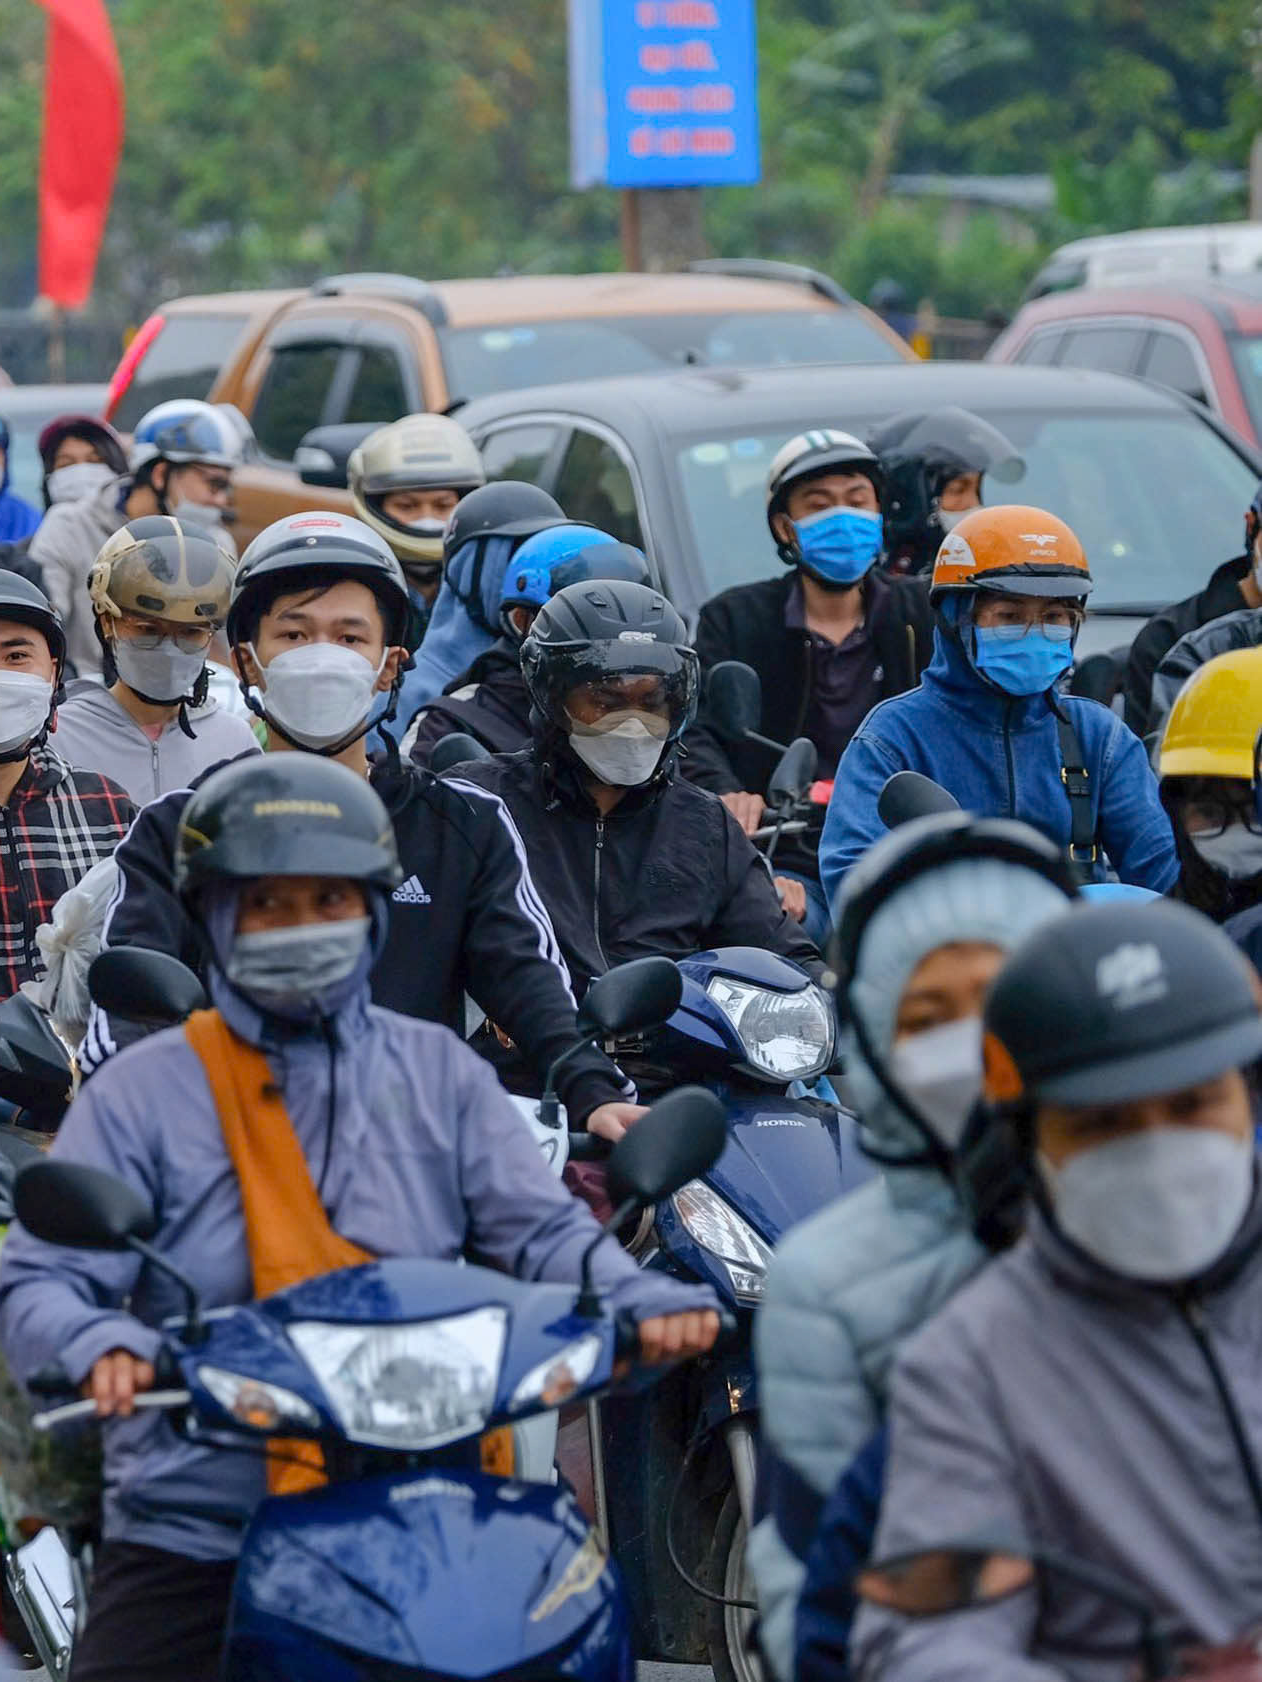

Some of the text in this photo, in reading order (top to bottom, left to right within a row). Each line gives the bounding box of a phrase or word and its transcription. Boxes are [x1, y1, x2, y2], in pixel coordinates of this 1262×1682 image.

[253, 799, 343, 819] HONDA
[392, 891, 432, 903] adidas
[756, 1119, 808, 1128] HONDA
